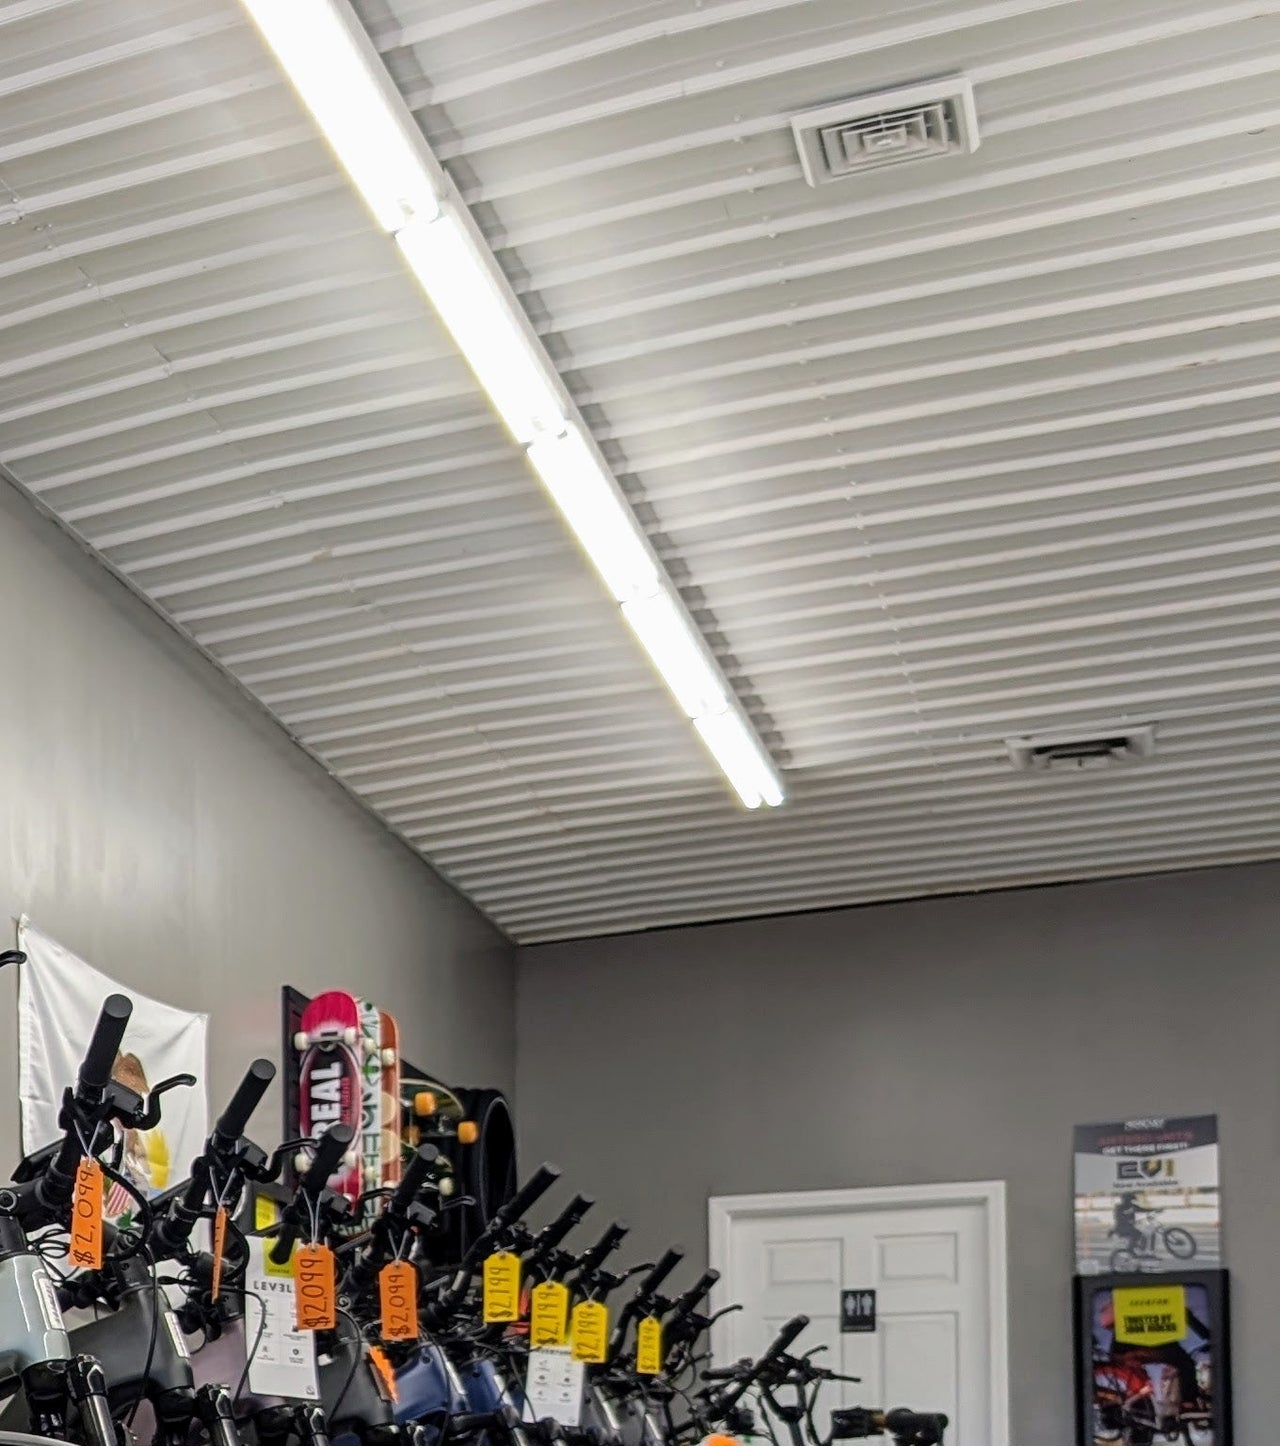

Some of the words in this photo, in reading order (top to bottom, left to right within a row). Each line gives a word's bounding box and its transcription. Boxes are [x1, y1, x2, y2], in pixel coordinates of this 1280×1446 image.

[73, 1170, 96, 1264] $2,099
[388, 1273, 411, 1337] $2,099
[488, 1266, 513, 1318] $2,199
